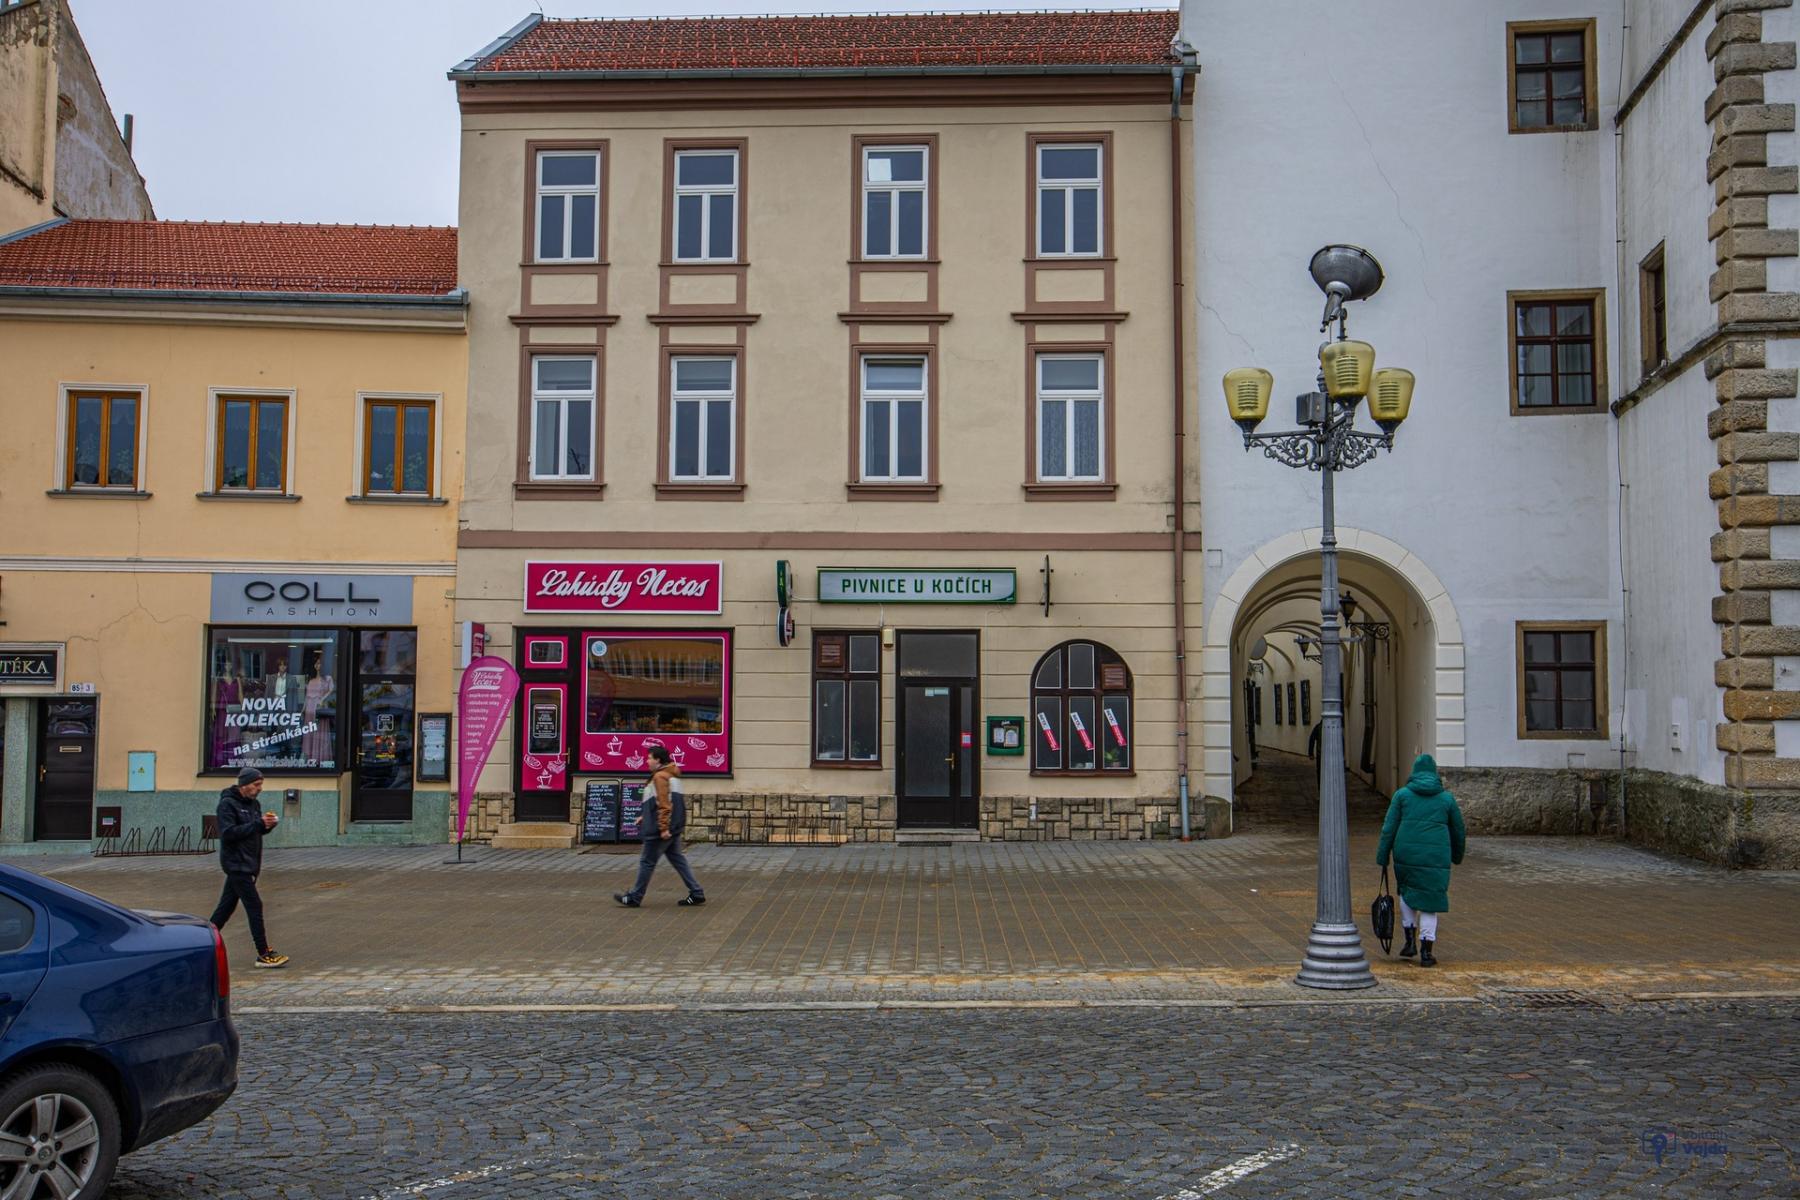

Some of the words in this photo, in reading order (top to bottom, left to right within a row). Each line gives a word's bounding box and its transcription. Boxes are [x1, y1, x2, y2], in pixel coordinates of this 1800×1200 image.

[636, 567, 711, 598] Nečas
[841, 578, 906, 594] PIVNICE
[914, 578, 924, 594] U
[932, 576, 992, 594] KOČÍCH
[244, 581, 380, 604] COLL
[246, 607, 378, 617] FASHION
[85, 684, 91, 692] 3
[242, 695, 287, 711] NOVÁ
[225, 713, 302, 728] KOLEKCE
[233, 745, 250, 756] na
[252, 721, 318, 751] stránkách
